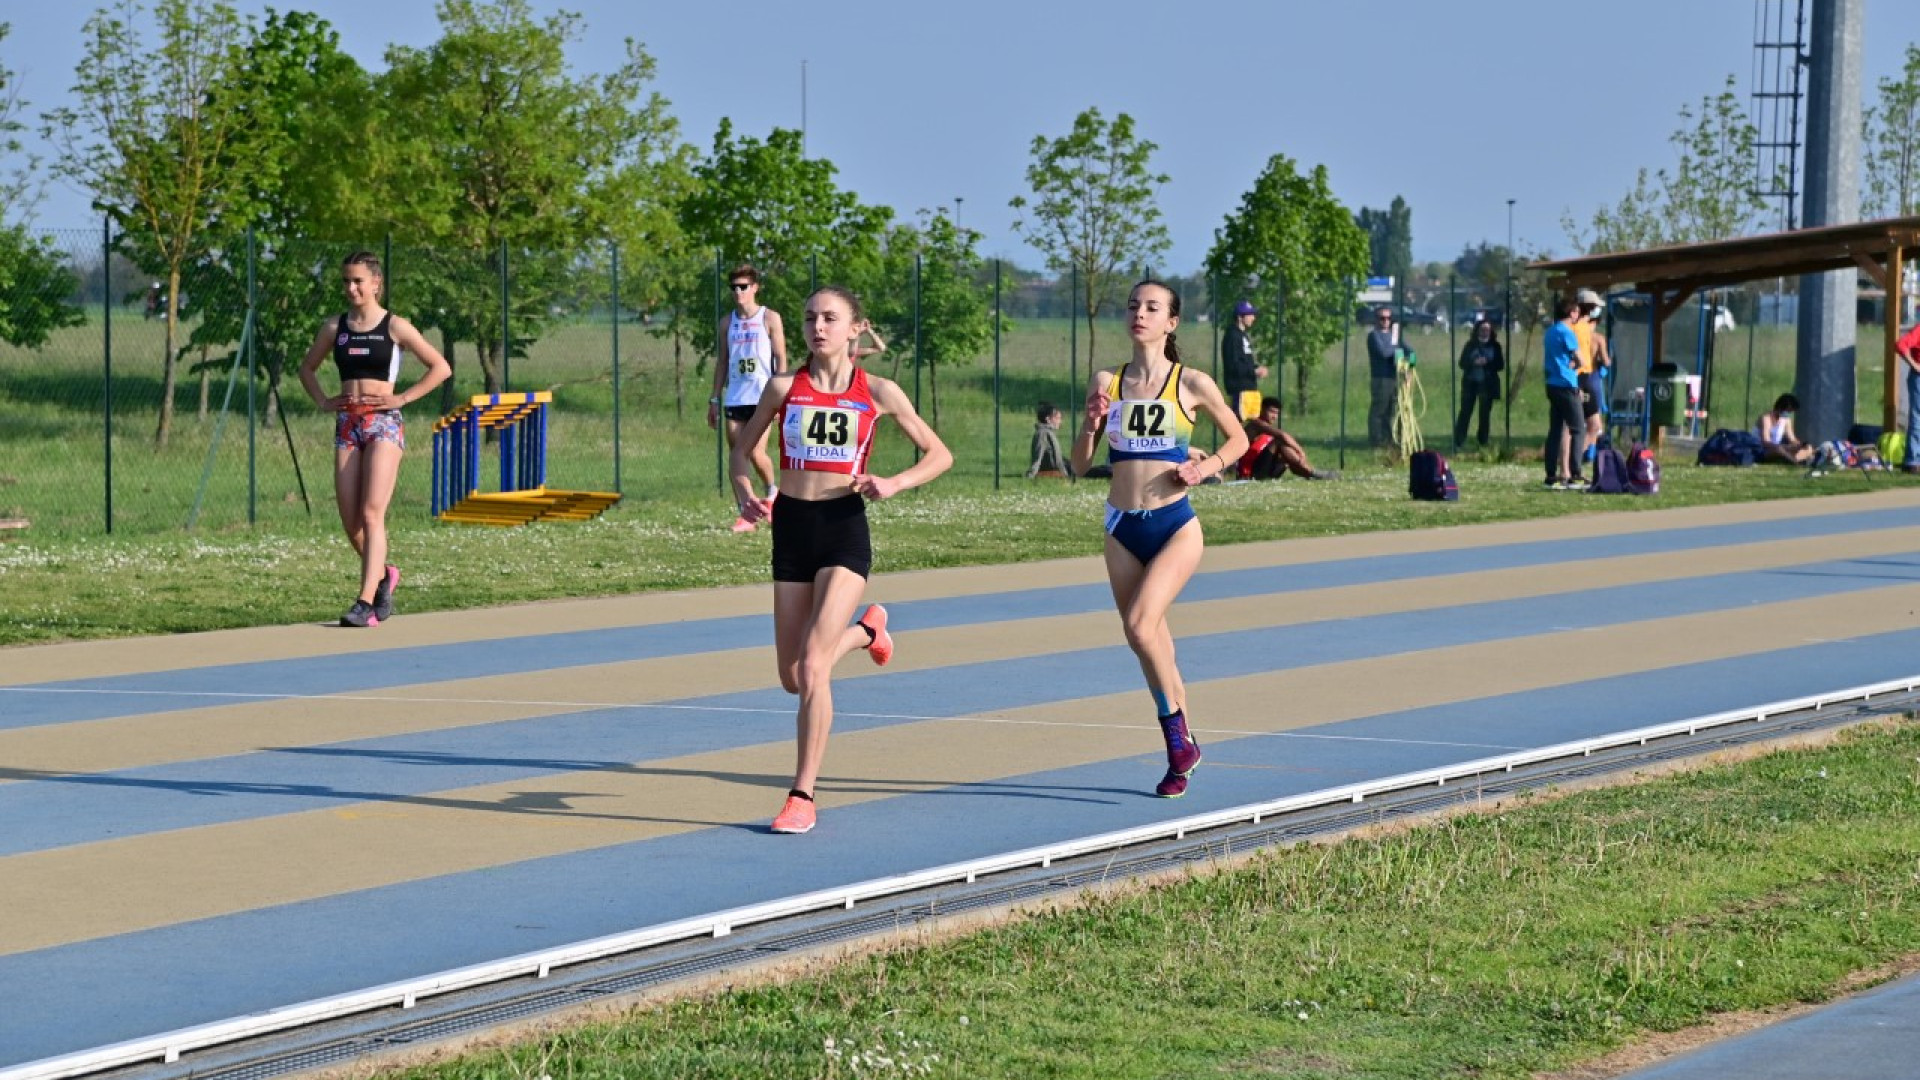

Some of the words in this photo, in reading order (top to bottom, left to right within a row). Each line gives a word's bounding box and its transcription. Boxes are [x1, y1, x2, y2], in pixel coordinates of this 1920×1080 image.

[739, 359, 755, 374] 35
[1128, 404, 1165, 436] 42
[807, 411, 848, 446] 43
[1128, 438, 1167, 448] FIDAL
[807, 447, 848, 457] FIDAL
